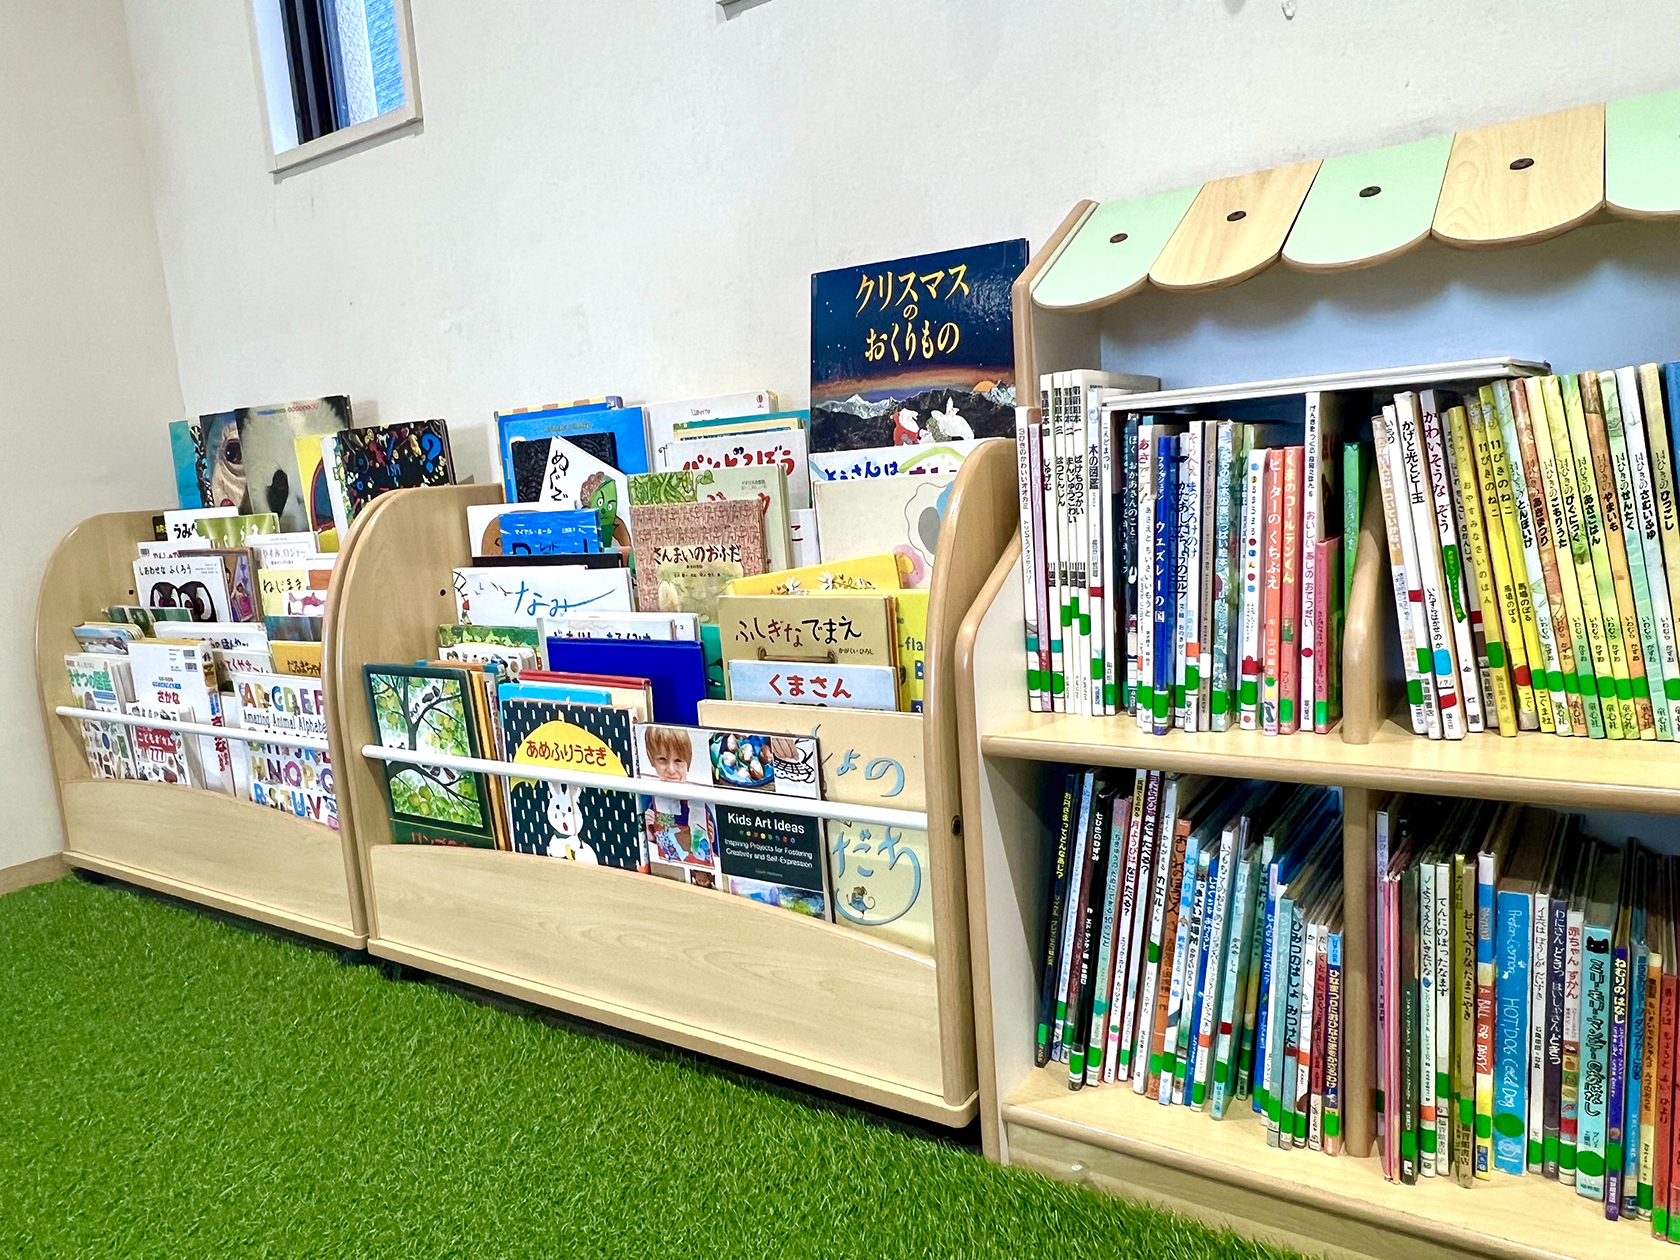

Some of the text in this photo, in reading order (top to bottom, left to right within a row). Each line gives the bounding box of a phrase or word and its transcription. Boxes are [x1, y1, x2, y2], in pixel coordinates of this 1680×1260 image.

[856, 264, 970, 316] クリスマス
[903, 304, 919, 320] の
[865, 320, 960, 363] おくりもの
[1088, 444, 1099, 490] 木の図鑑
[1402, 421, 1425, 504] かげと光とビー玉
[1423, 411, 1449, 533] かわいそうな ぞう
[1490, 439, 1513, 515] 11ぴきのねこ
[1655, 450, 1674, 530] 14ひきのひっこし
[1187, 483, 1200, 559] まっくろけのけ
[1266, 460, 1281, 590] ピーターのくちぶえ
[1283, 452, 1296, 584] くまのコールテンくん
[1305, 511, 1315, 546] おいしい
[653, 544, 742, 565] さんまいのおふだ
[157, 690, 180, 704] さかな
[769, 674, 852, 700] くまさん
[244, 710, 270, 728] Amazing
[273, 714, 296, 729] Animal
[526, 740, 607, 768] あめふりうさぎ
[728, 812, 805, 834] Kids Art Ideas
[724, 838, 813, 860] Inspiring Projects for Fostering
[725, 847, 813, 868] Creativity and Self-Expression
[1436, 897, 1449, 996] てんにのぼったなまず
[1462, 910, 1475, 1021] おしゃべりなたまごやき
[1566, 971, 1579, 999] ずかん
[1478, 999, 1491, 1018] BALL
[1478, 1024, 1489, 1040] FOR
[1476, 1044, 1488, 1072] DAISY
